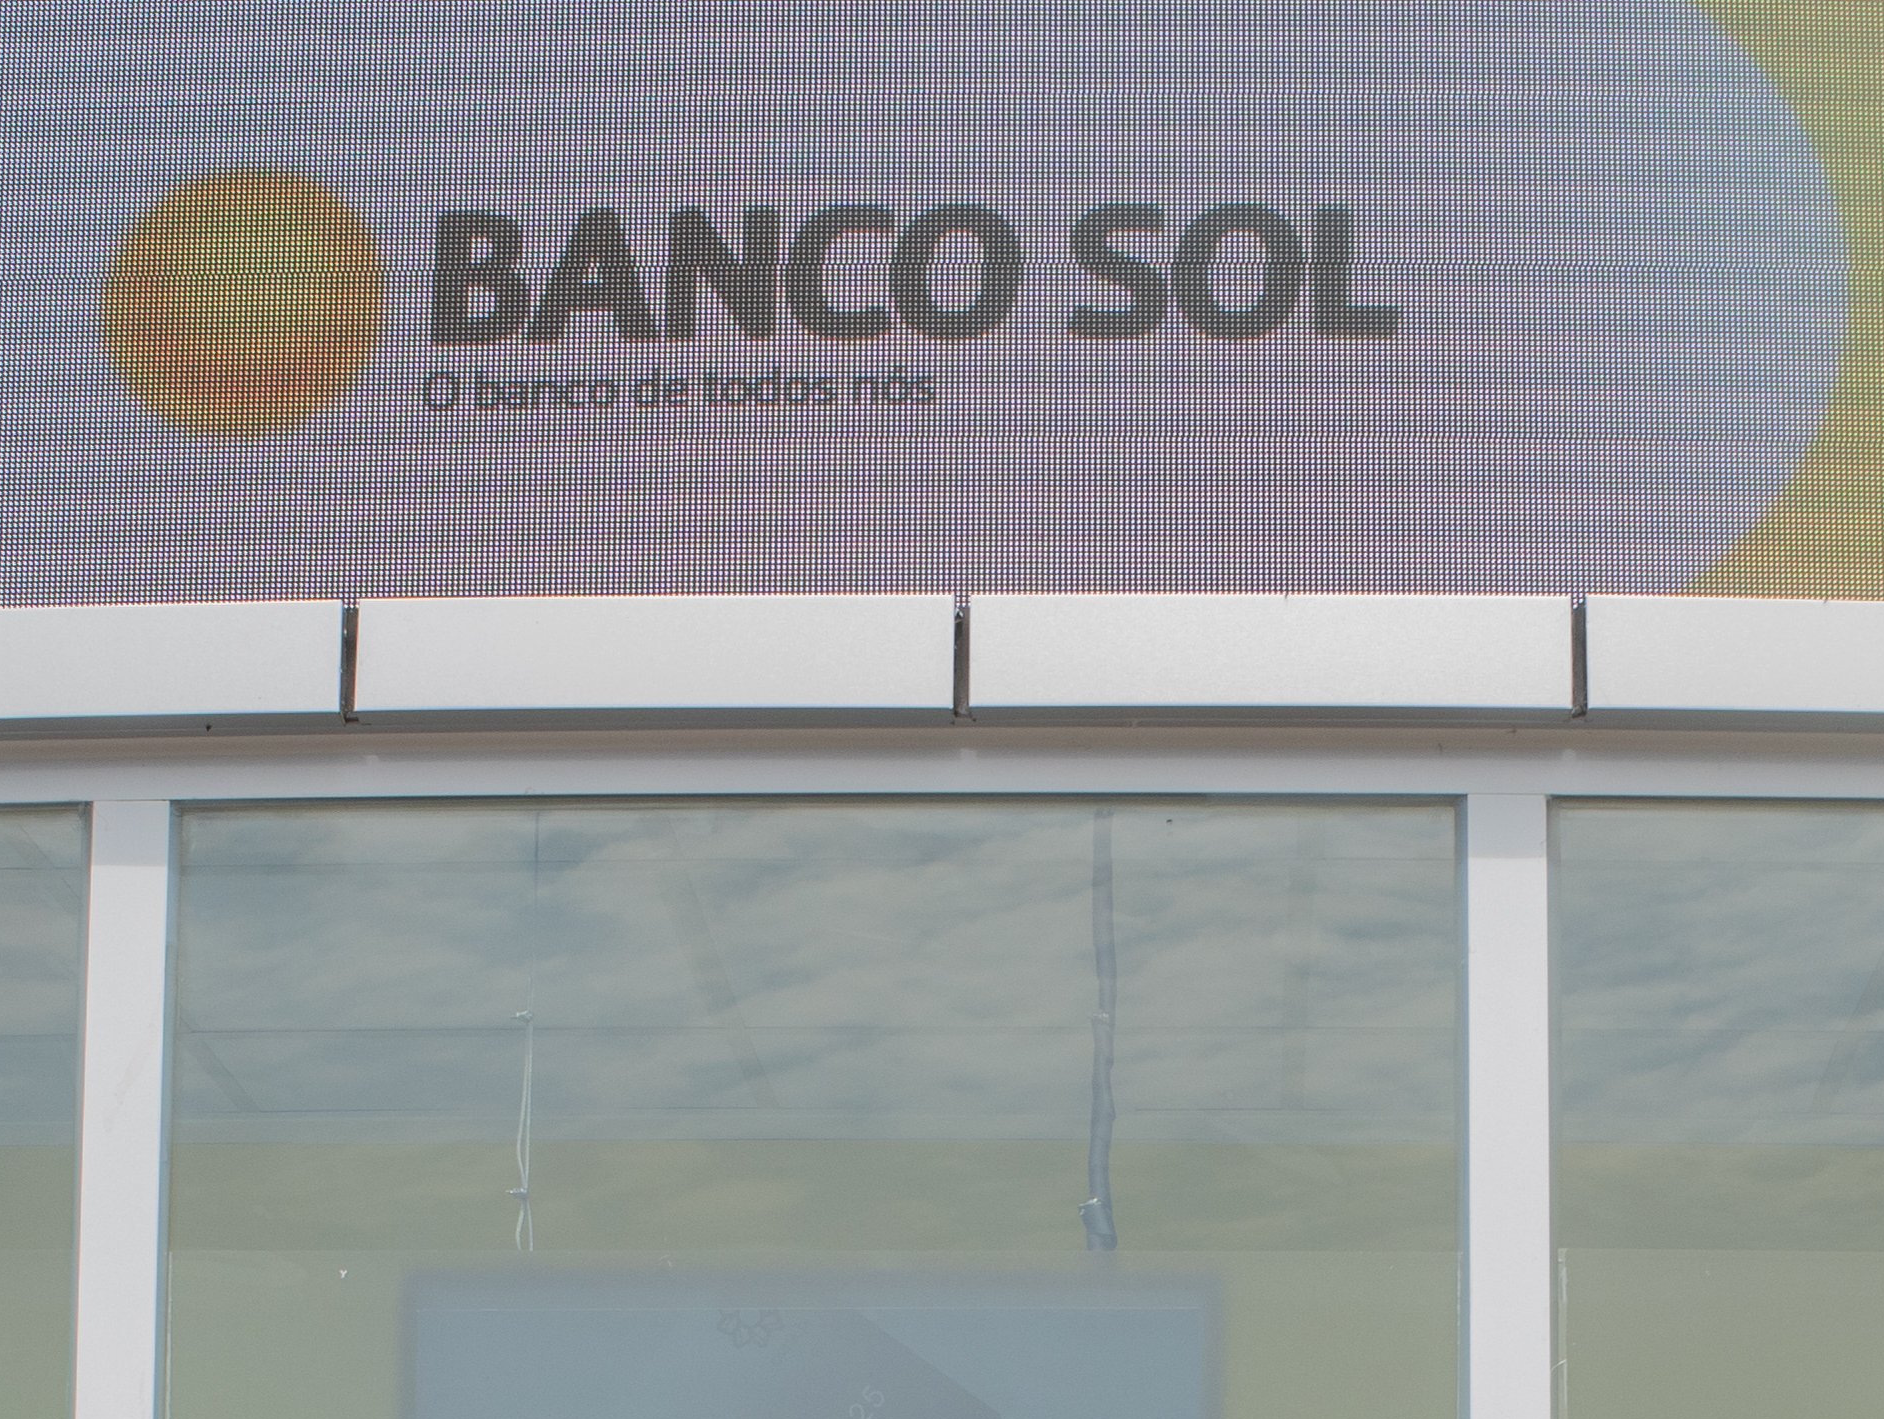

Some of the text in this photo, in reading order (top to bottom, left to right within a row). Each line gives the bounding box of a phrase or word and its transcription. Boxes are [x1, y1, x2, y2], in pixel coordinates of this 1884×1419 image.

[428, 202, 1403, 346] BANCO SOL
[421, 365, 937, 409] O banco de todos nós
